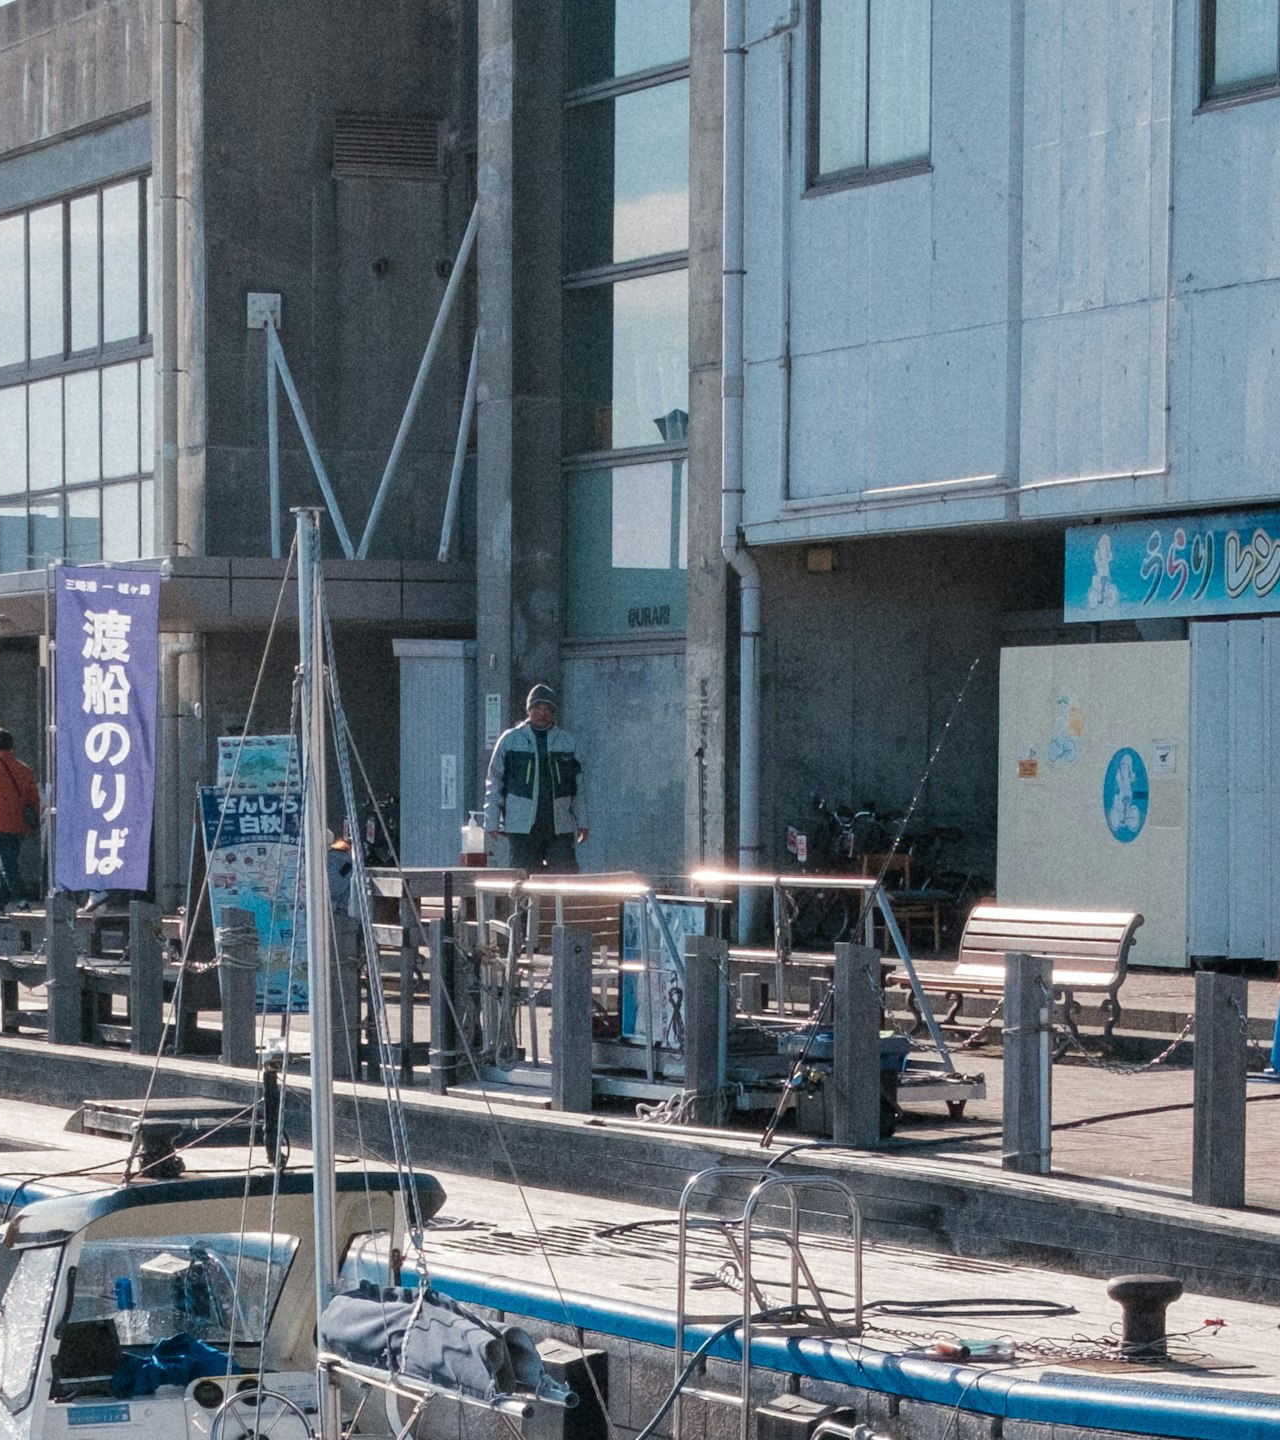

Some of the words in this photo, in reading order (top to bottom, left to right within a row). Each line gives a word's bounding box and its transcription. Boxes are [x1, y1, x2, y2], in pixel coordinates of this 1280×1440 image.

[1140, 528, 1214, 607] うらり
[82, 610, 131, 875] 渡船のりば
[238, 815, 282, 834] 白秋
